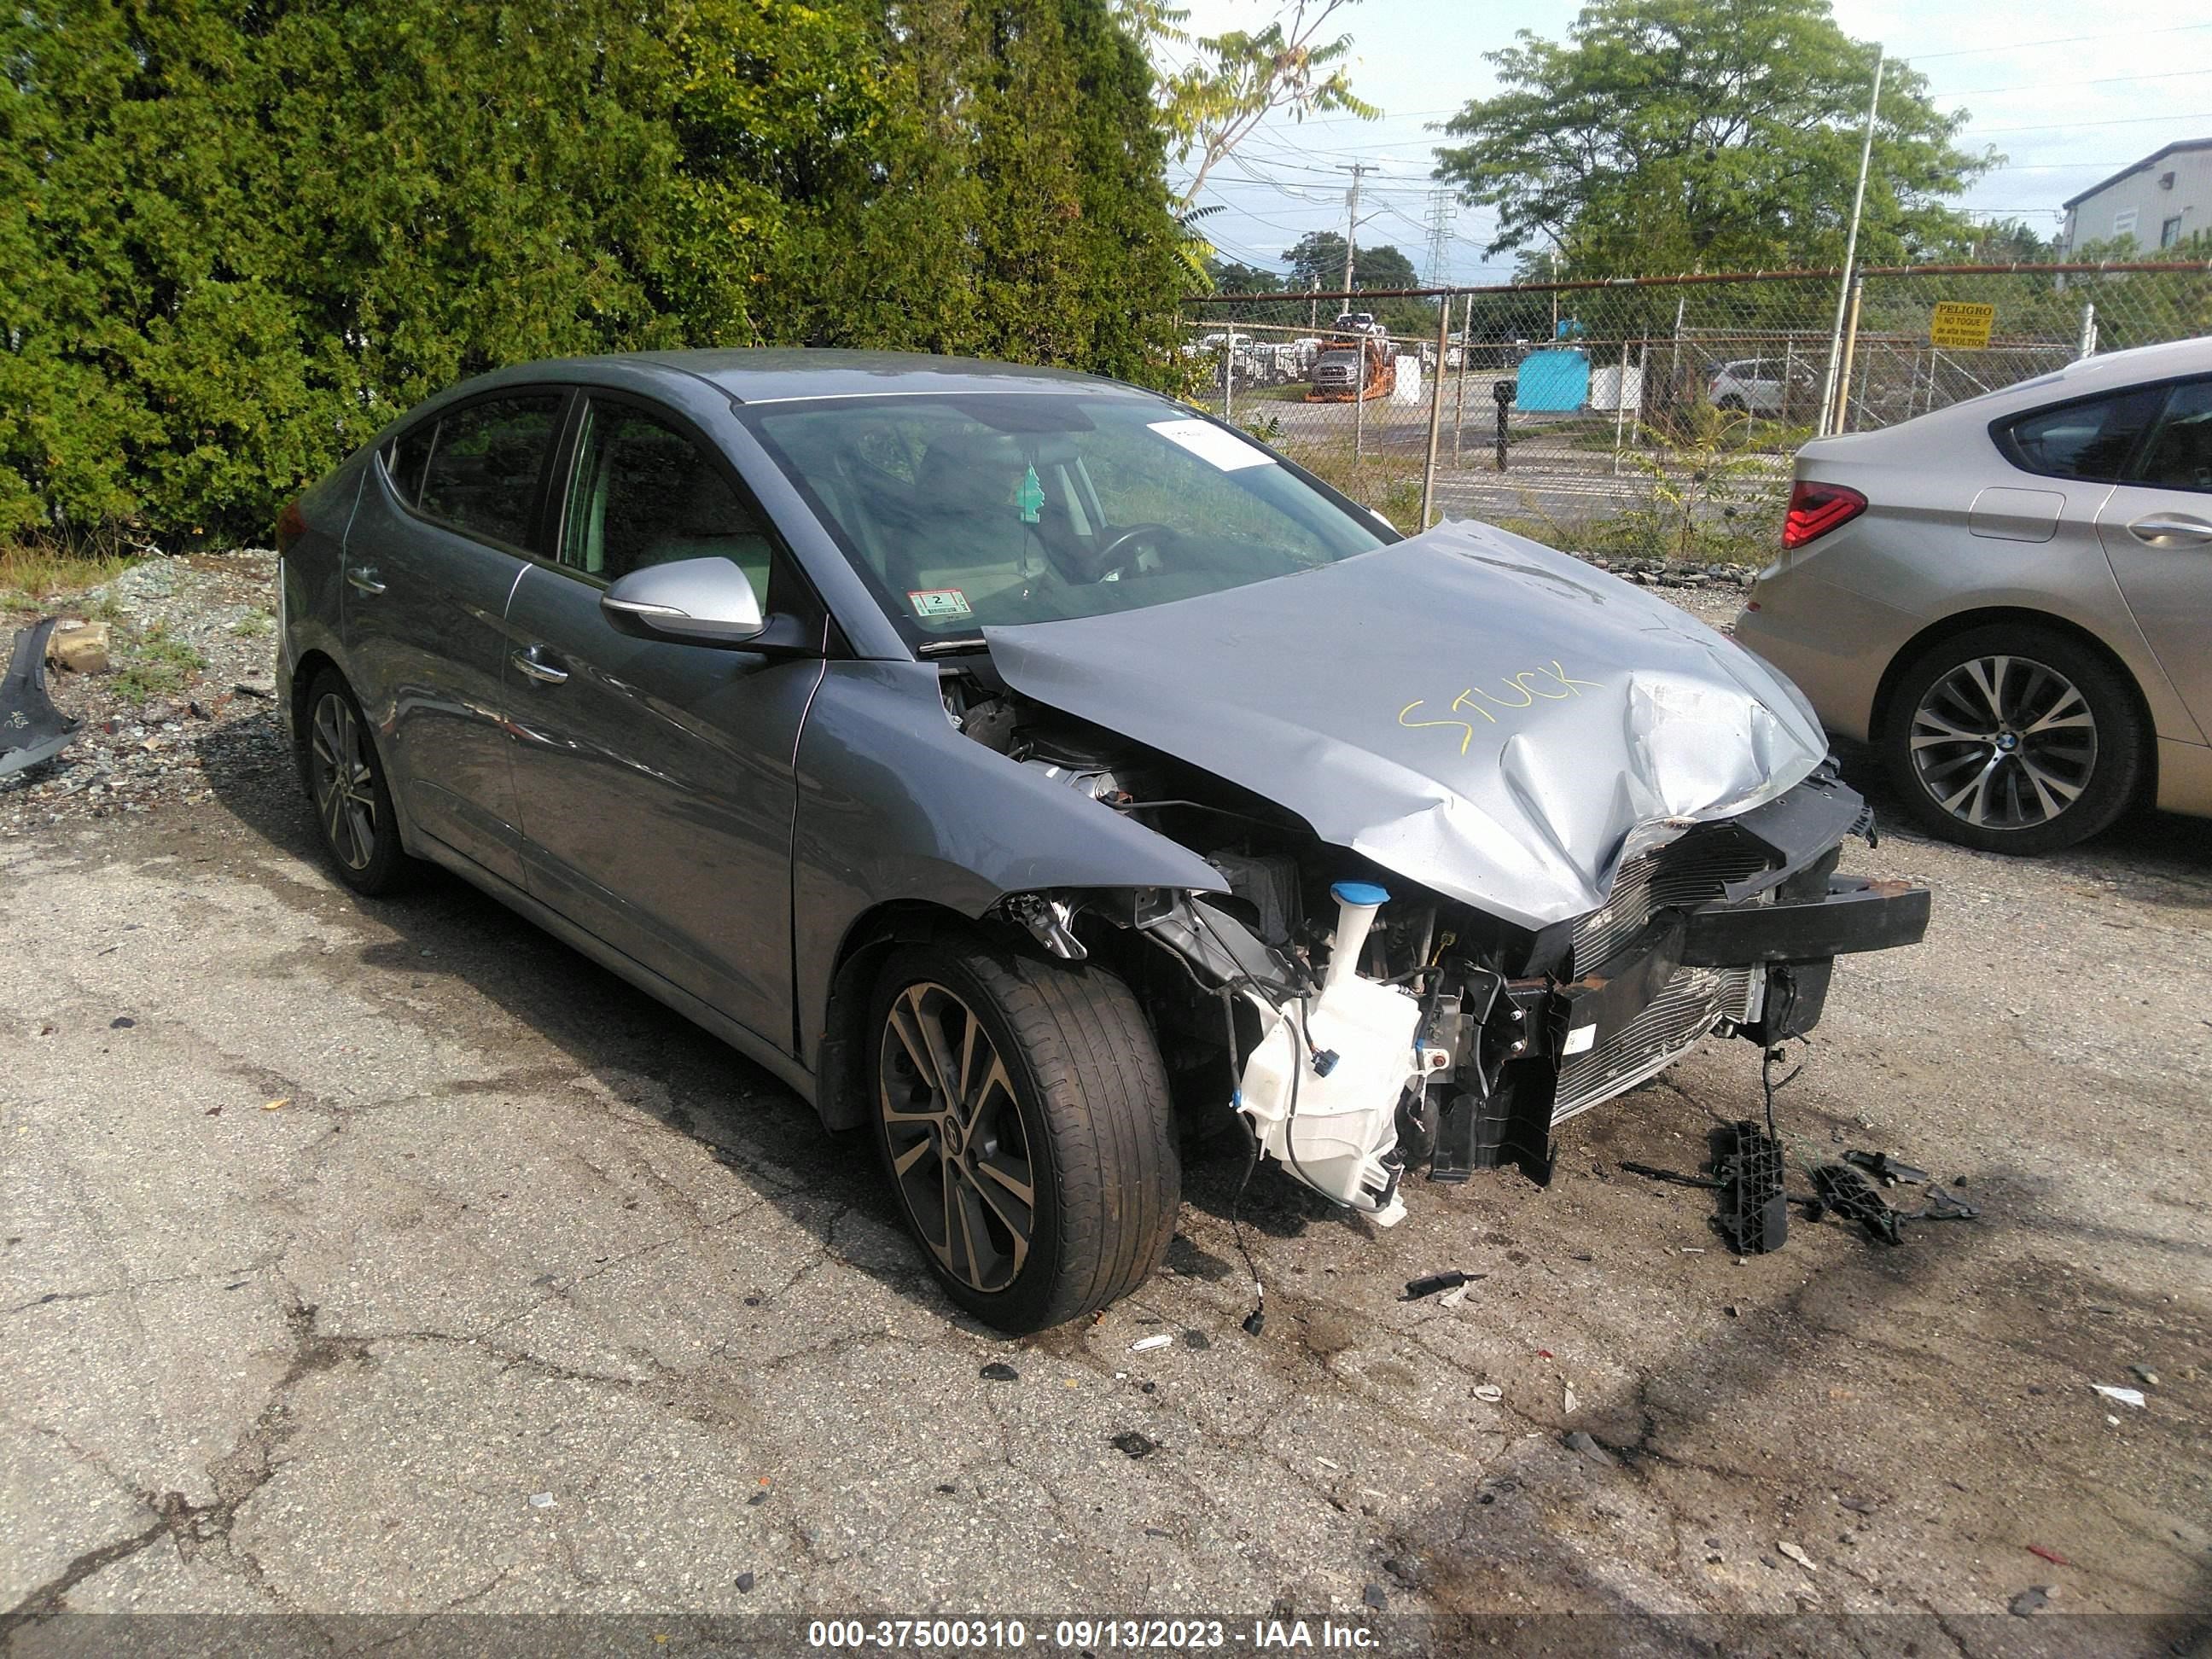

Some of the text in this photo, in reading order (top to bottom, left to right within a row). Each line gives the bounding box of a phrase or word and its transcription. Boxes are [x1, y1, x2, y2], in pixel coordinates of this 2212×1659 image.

[1939, 305, 1992, 316] PELIGRO
[1957, 317, 1981, 326] TOQUE
[1952, 337, 1986, 346] VOLTIOS
[932, 596, 943, 604] 2
[1399, 660, 1605, 755] STUCK
